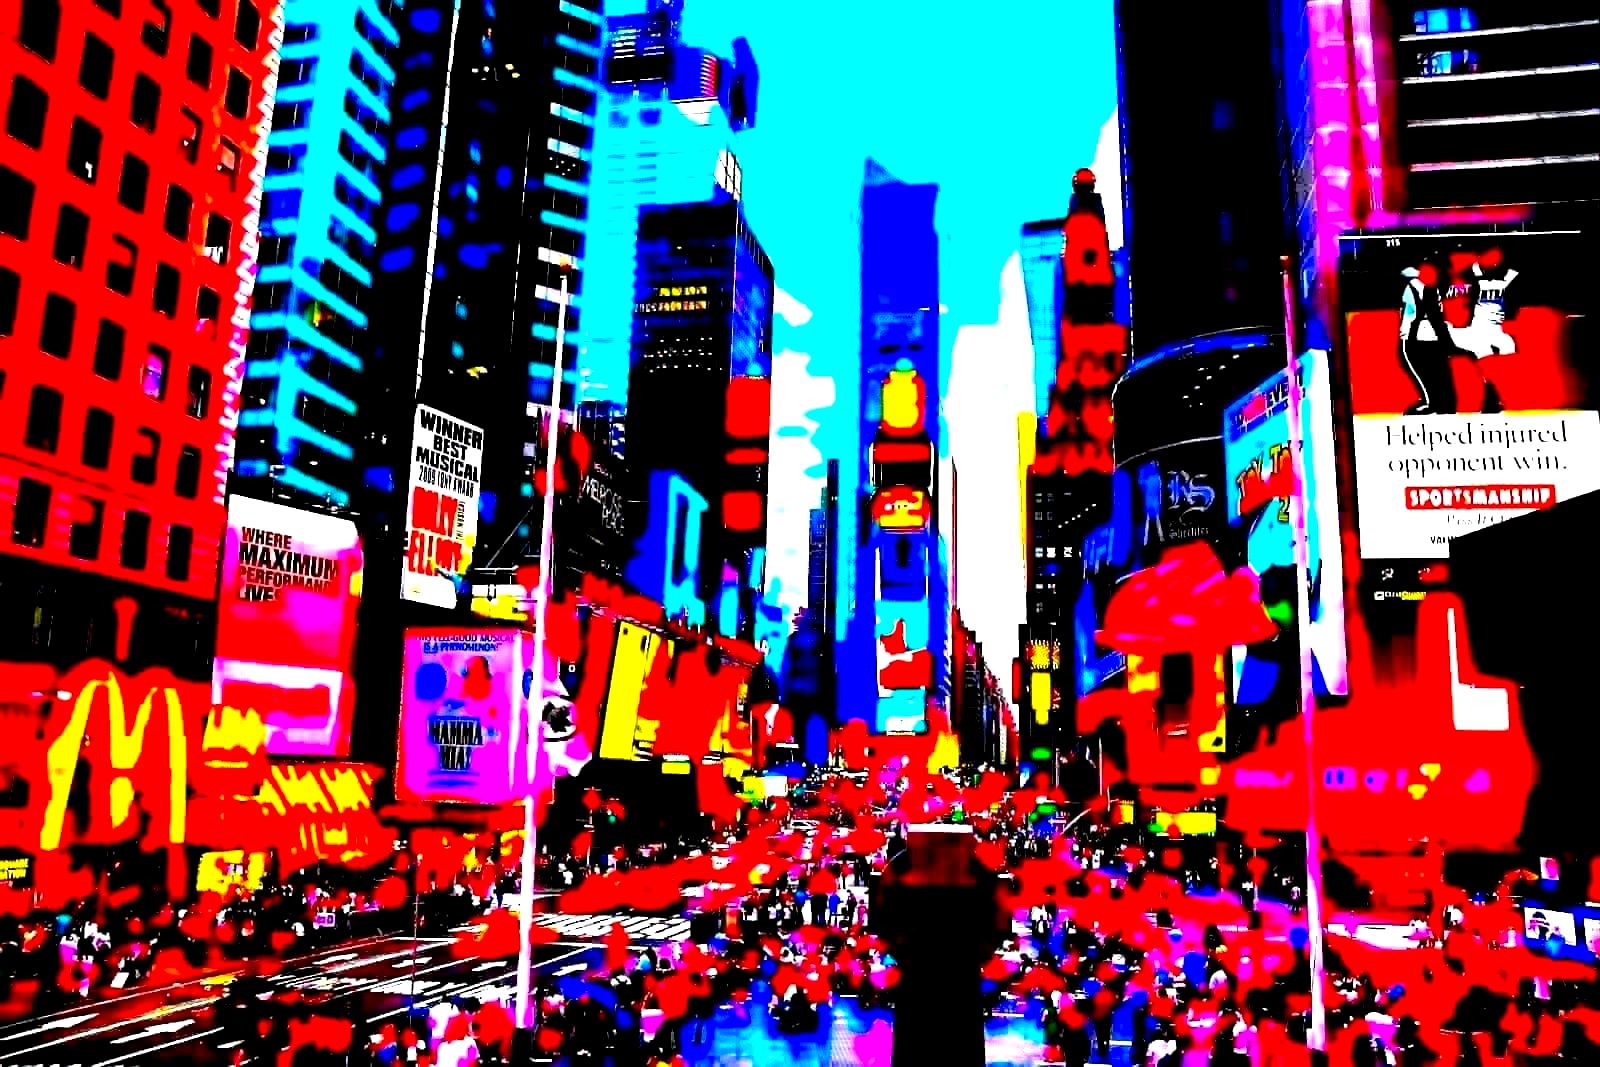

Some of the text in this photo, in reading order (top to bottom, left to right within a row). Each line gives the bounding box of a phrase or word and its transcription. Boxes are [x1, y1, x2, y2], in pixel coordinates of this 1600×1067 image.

[420, 408, 482, 451] WINNER
[1386, 419, 1568, 451] Helped injured
[433, 433, 468, 461] BEST
[416, 446, 479, 483] MUSICAL
[419, 464, 437, 485] 2009
[437, 470, 453, 491] TONY
[1388, 448, 1568, 479] opponent win.
[1409, 487, 1551, 506] SPORTSMANSHIP
[242, 526, 292, 550] WHERE
[239, 542, 338, 581] MAXIMUM
